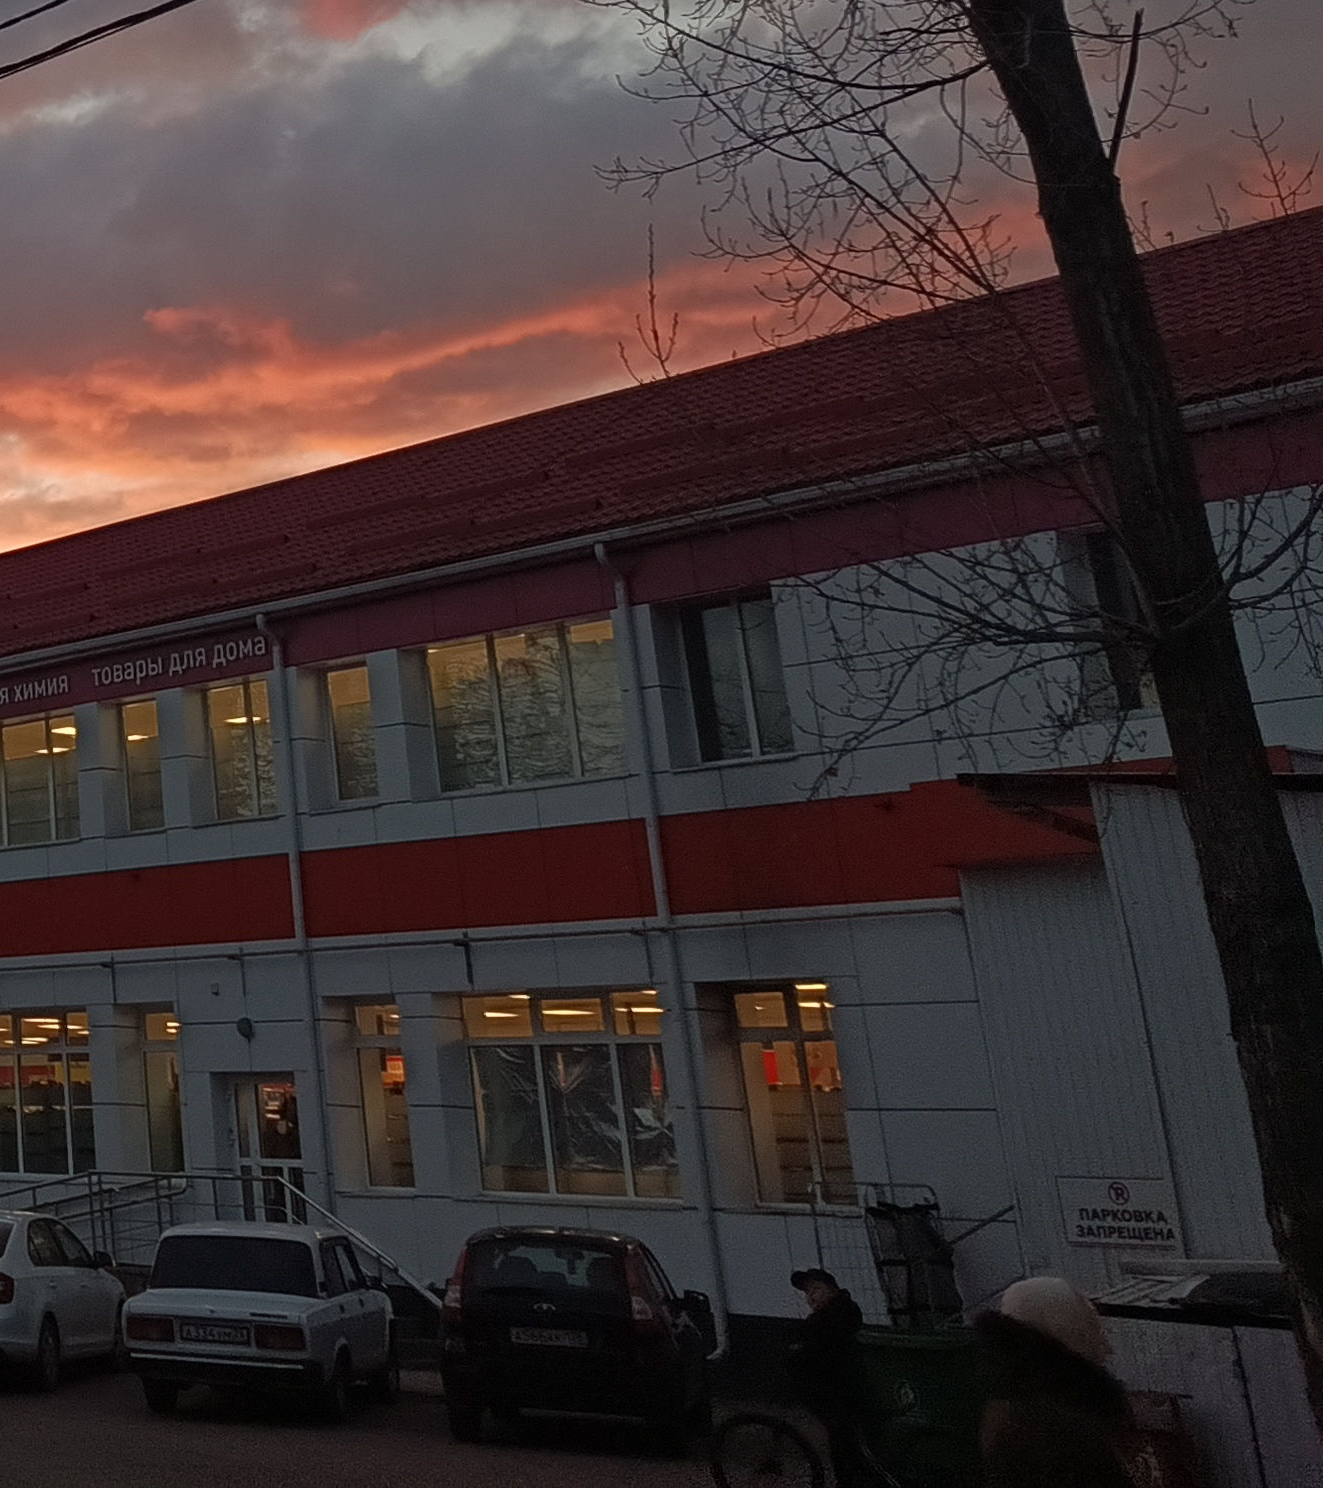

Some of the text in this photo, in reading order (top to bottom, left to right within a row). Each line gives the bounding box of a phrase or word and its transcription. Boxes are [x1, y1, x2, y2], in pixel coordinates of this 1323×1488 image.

[14, 674, 69, 703] химия
[91, 654, 163, 688] товары
[168, 647, 206, 676] для
[212, 635, 267, 669] дома
[1078, 1208, 1168, 1224] ПАРКОВКА
[1075, 1224, 1176, 1241] ЗАПРЕЩЕНА
